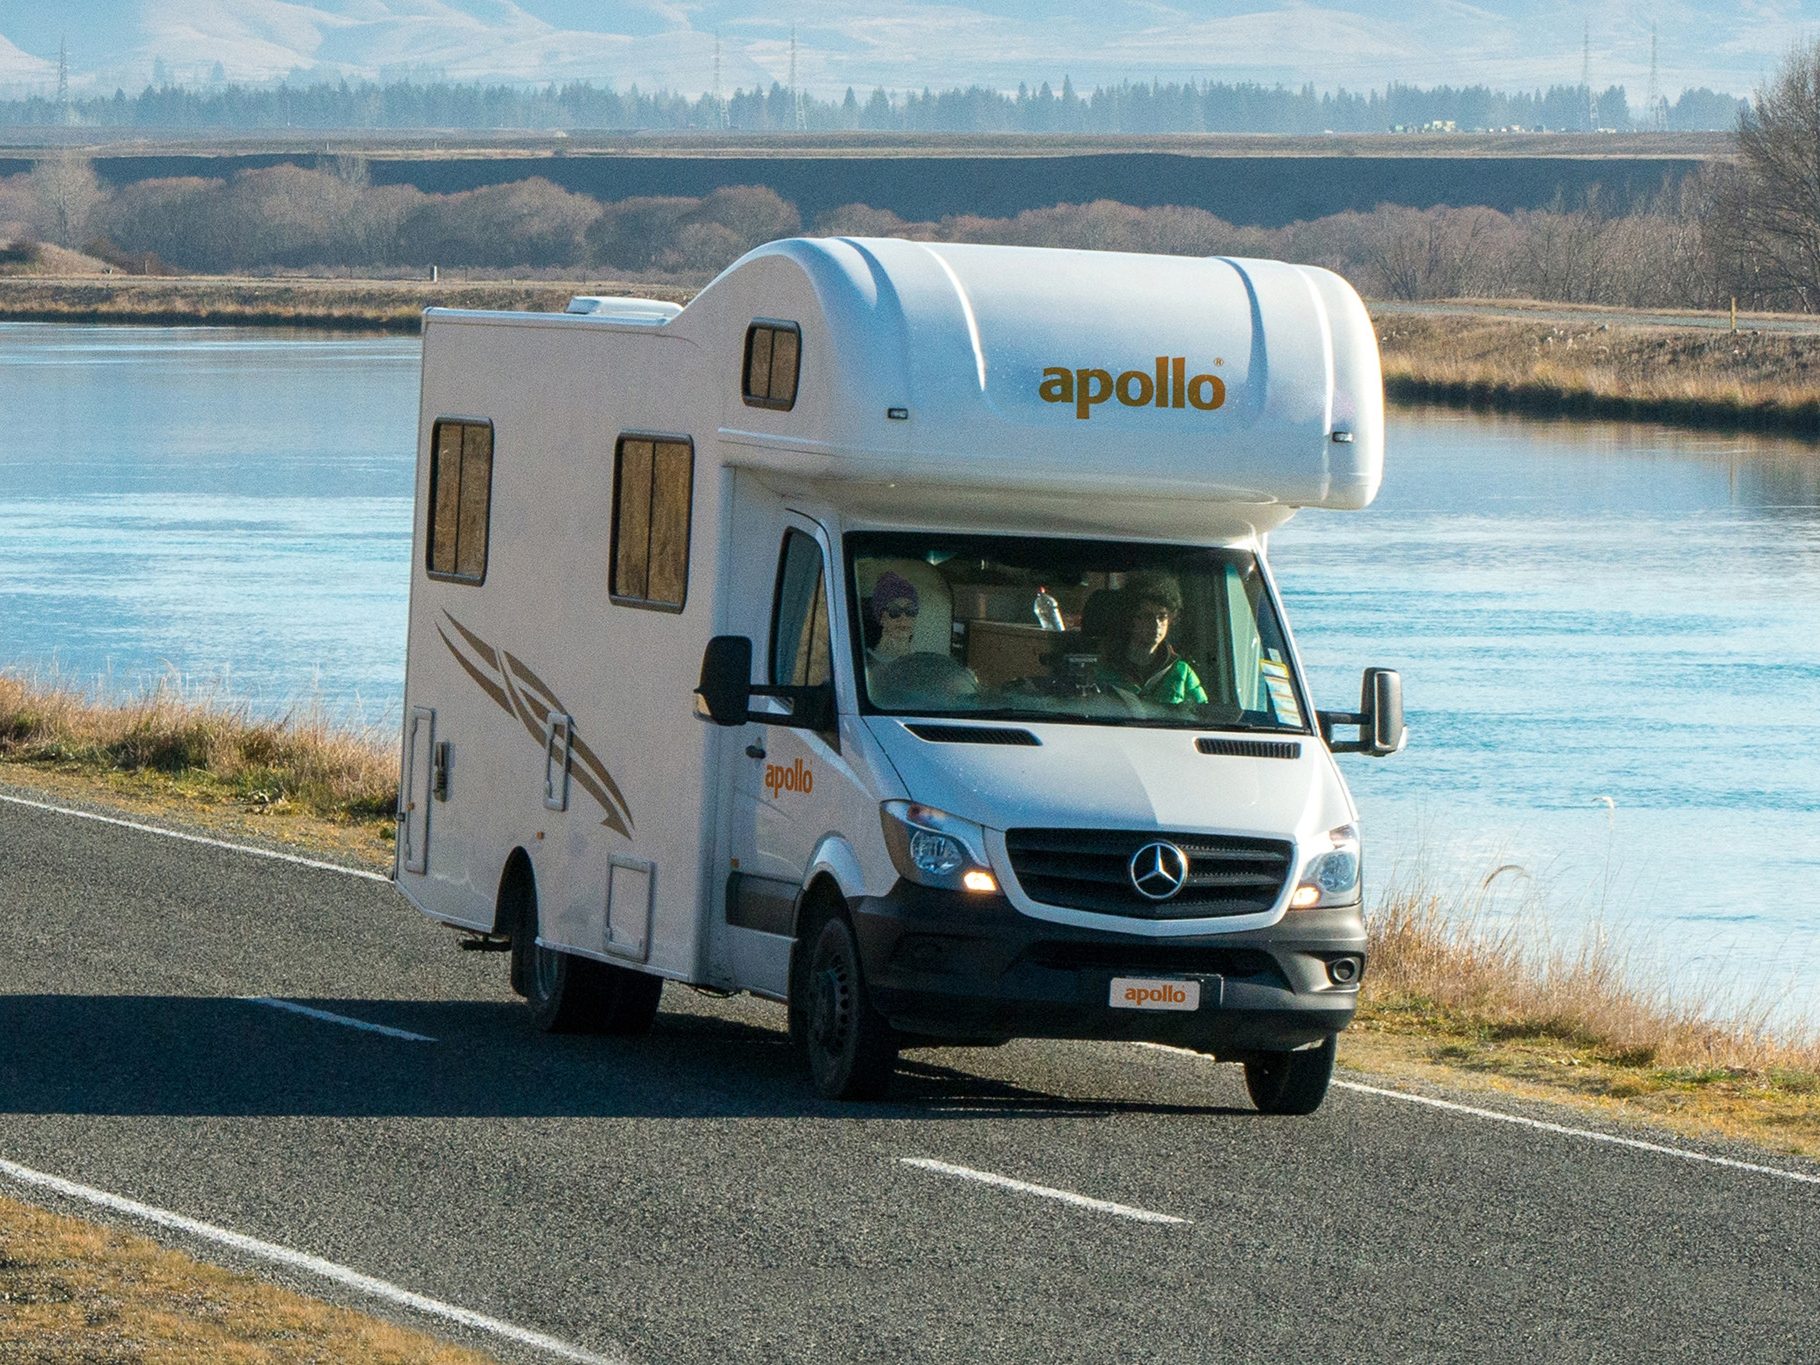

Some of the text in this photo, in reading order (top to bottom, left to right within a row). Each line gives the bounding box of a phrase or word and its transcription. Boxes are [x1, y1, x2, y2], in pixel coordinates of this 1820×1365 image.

[1039, 356, 1226, 419] apollo
[765, 758, 813, 799] apollo
[1124, 984, 1186, 1006] apollo
